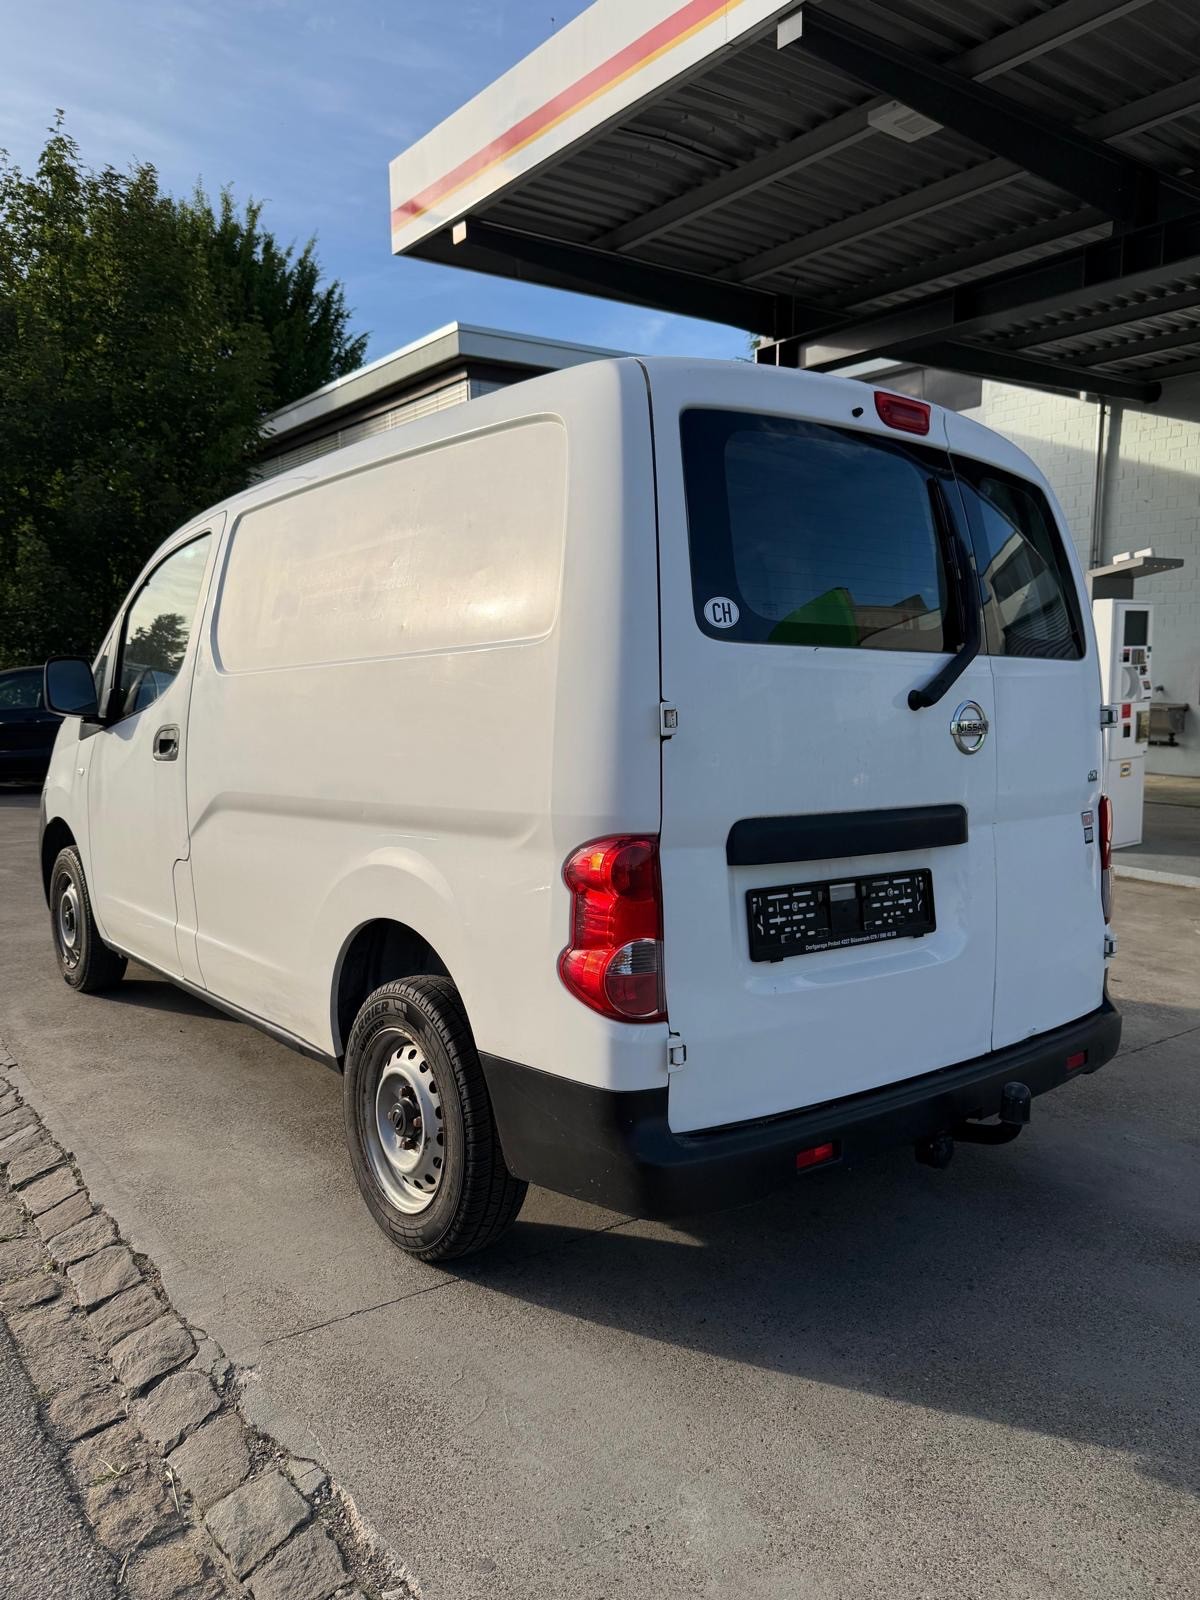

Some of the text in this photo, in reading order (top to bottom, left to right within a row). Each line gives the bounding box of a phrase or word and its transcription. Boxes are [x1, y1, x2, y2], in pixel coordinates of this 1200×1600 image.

[712, 602, 732, 623] CH
[957, 723, 987, 731] NISSAN
[805, 943, 828, 951] Dorfgarage
[349, 1000, 390, 1056] CARRIER
[359, 1019, 385, 1051] WINTER
